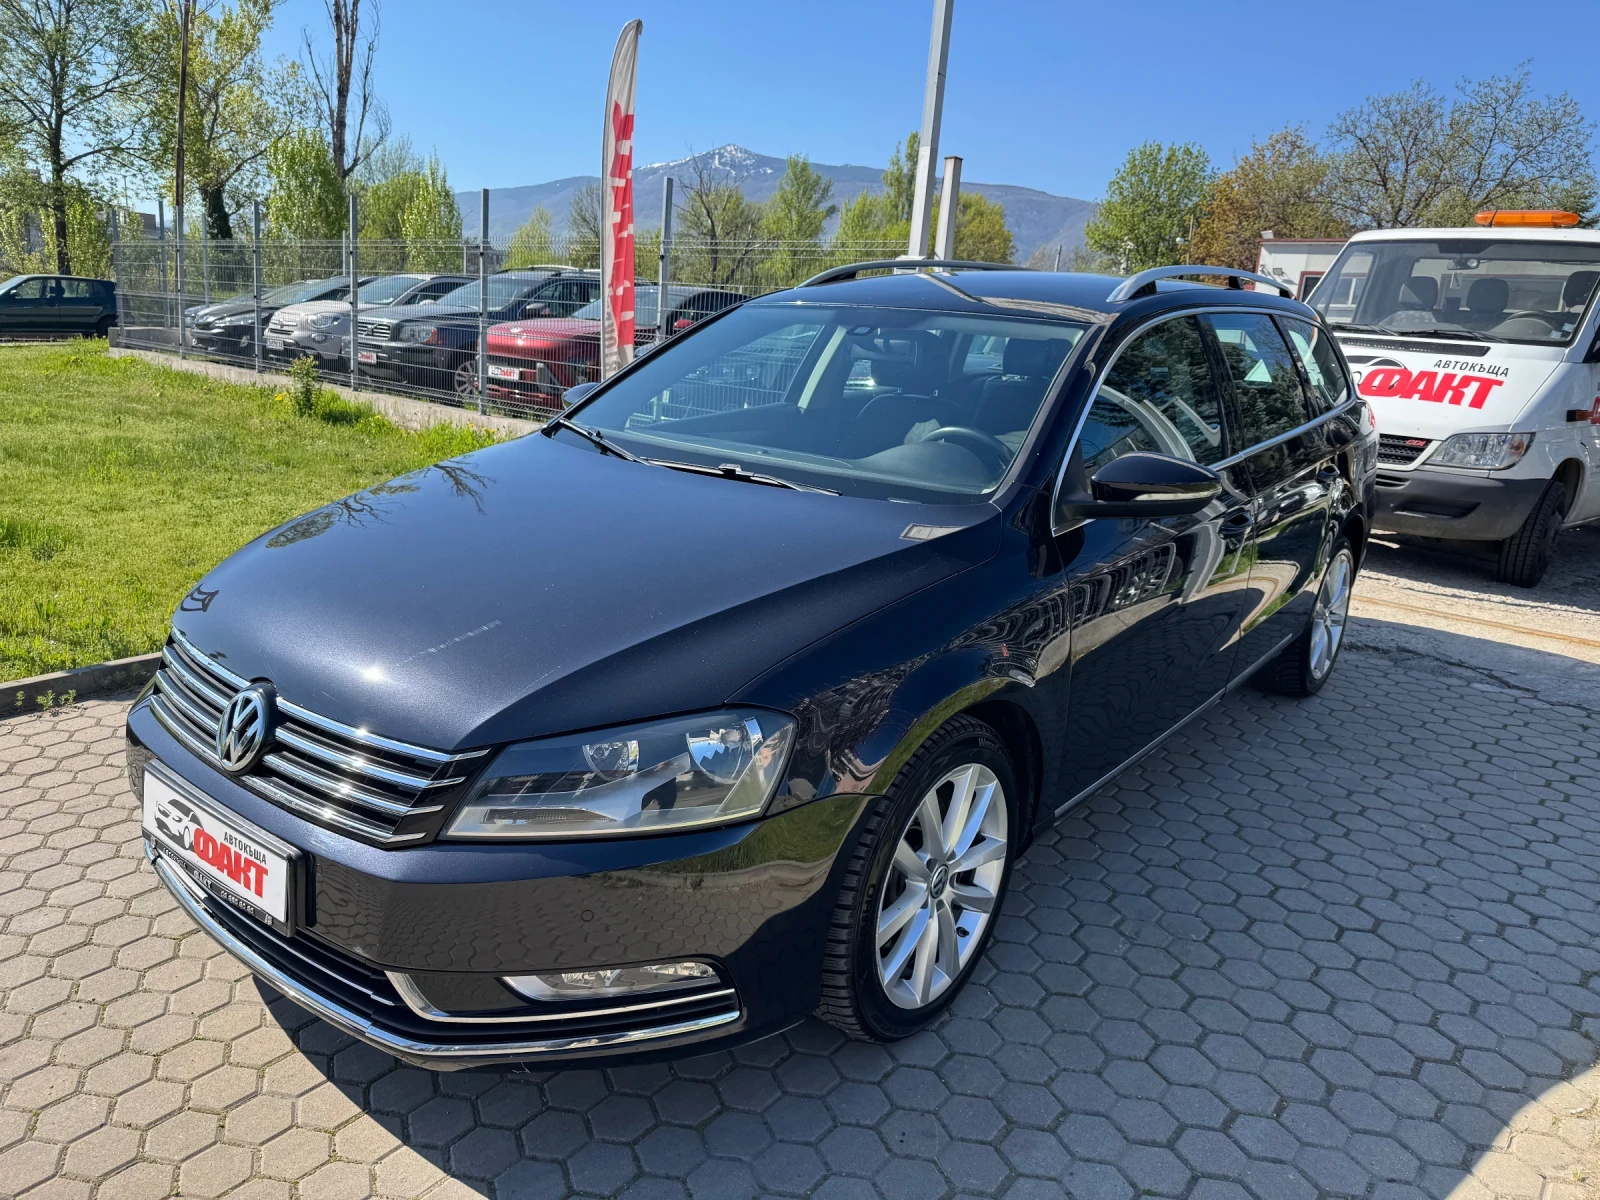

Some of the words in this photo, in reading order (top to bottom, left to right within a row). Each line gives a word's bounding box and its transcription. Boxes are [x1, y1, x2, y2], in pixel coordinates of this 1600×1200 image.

[1433, 359, 1509, 378] АВТОКЪЩА
[1357, 367, 1504, 410] ФАКТ
[1405, 439, 1427, 447] CDI
[193, 827, 269, 899] ФАКТ
[223, 831, 267, 866] АВТОКЪЩА
